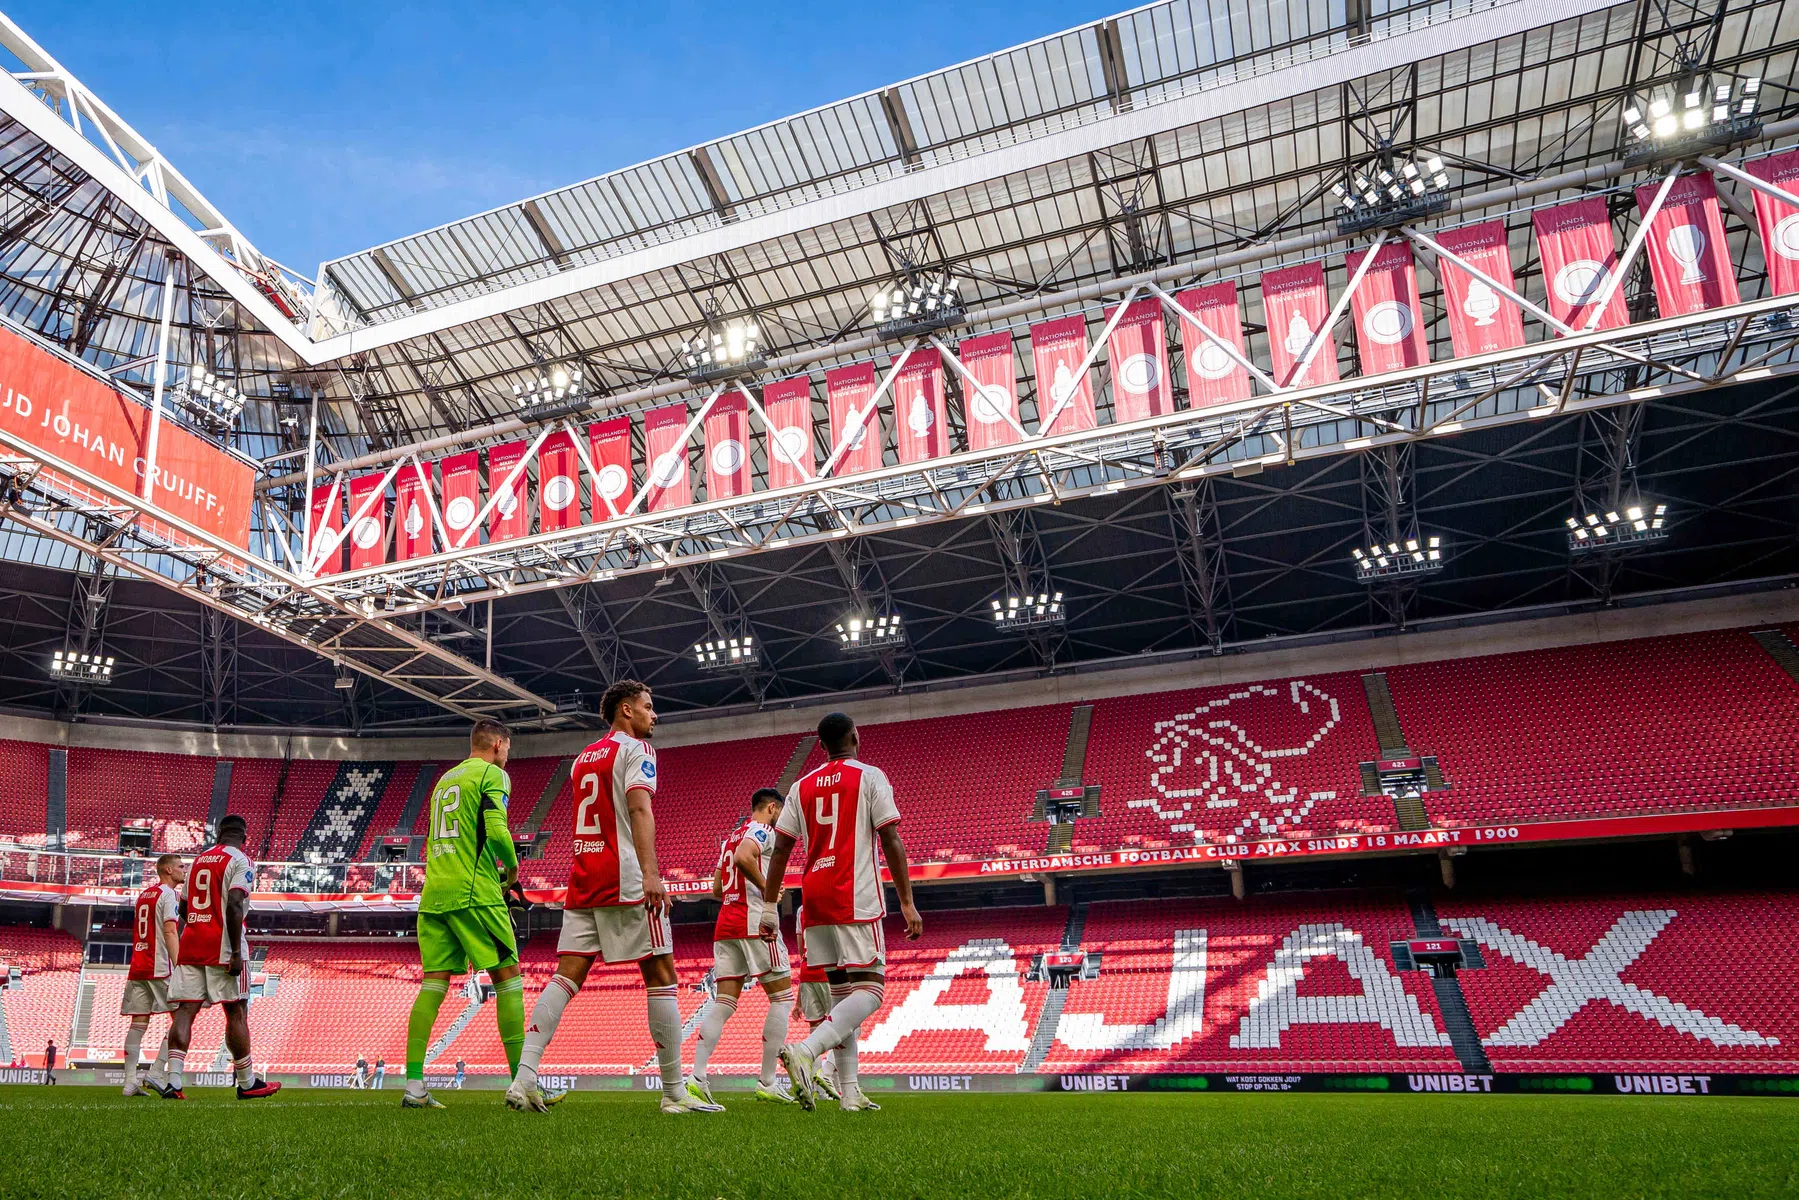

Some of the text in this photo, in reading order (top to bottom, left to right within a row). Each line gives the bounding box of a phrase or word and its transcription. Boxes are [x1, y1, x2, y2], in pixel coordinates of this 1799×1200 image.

[1772, 167, 1799, 178] LAND
[1665, 190, 1699, 202] ROPESE
[1660, 197, 1700, 211] UPERCUP
[1549, 222, 1595, 236] KAMPIOEN
[1556, 216, 1585, 228] LANDS
[1447, 236, 1495, 252] NATIONALE
[1473, 250, 1499, 260] BEKER
[1352, 255, 1407, 272] NERLANDSE
[1365, 264, 1400, 277] UPERCUP
[1271, 277, 1313, 290] NATIONALE
[1195, 298, 1219, 308] LANDS
[1039, 329, 1077, 341] NATIONALE
[964, 344, 1008, 358] NEDERLANDSE
[1386, 362, 1404, 370] 2002
[833, 375, 867, 387] NATIONALE
[777, 390, 796, 399] LANDS
[0, 383, 32, 418] JD
[41, 408, 125, 467] JOHAN
[592, 428, 627, 440] NEDERLANDSE
[816, 772, 841, 787] HATO
[575, 772, 601, 835] 2
[433, 784, 460, 841] 12
[816, 793, 839, 850] 4
[980, 826, 1520, 873] AMSTERDAMSCHE FOOTBALL CLUB AJAX SINDS 18 MAART 1900
[123, 889, 141, 898] CU
[191, 868, 212, 910] 9
[663, 881, 715, 892] ERELDBE
[138, 903, 150, 939] 8
[858, 909, 1781, 1054] AJAX
[195, 1074, 233, 1086] UNIBE
[310, 1075, 357, 1087] UNIBE
[538, 1076, 578, 1089] NIBET
[909, 1075, 972, 1091] UNIBET
[1060, 1075, 1130, 1092] UNIBET
[1408, 1073, 1494, 1092] UNIBET
[1614, 1075, 1712, 1094] UNIBET
